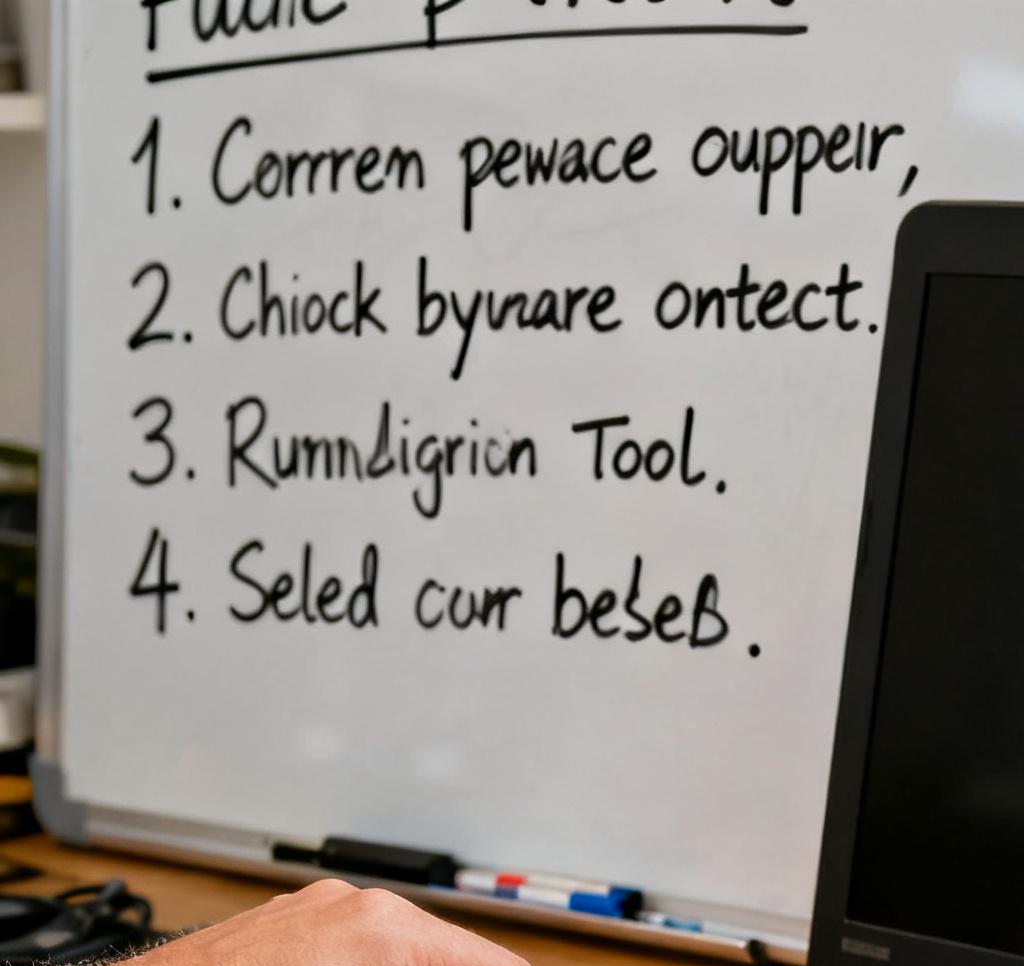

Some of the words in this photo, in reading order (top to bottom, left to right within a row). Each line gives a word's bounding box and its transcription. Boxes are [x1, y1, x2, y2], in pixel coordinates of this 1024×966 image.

[131, 116, 182, 215] 1.
[127, 261, 194, 351] 2.
[220, 258, 388, 341] Chiock
[130, 396, 196, 487] 3.
[571, 406, 727, 495] Tool.
[128, 527, 196, 634] 4.
